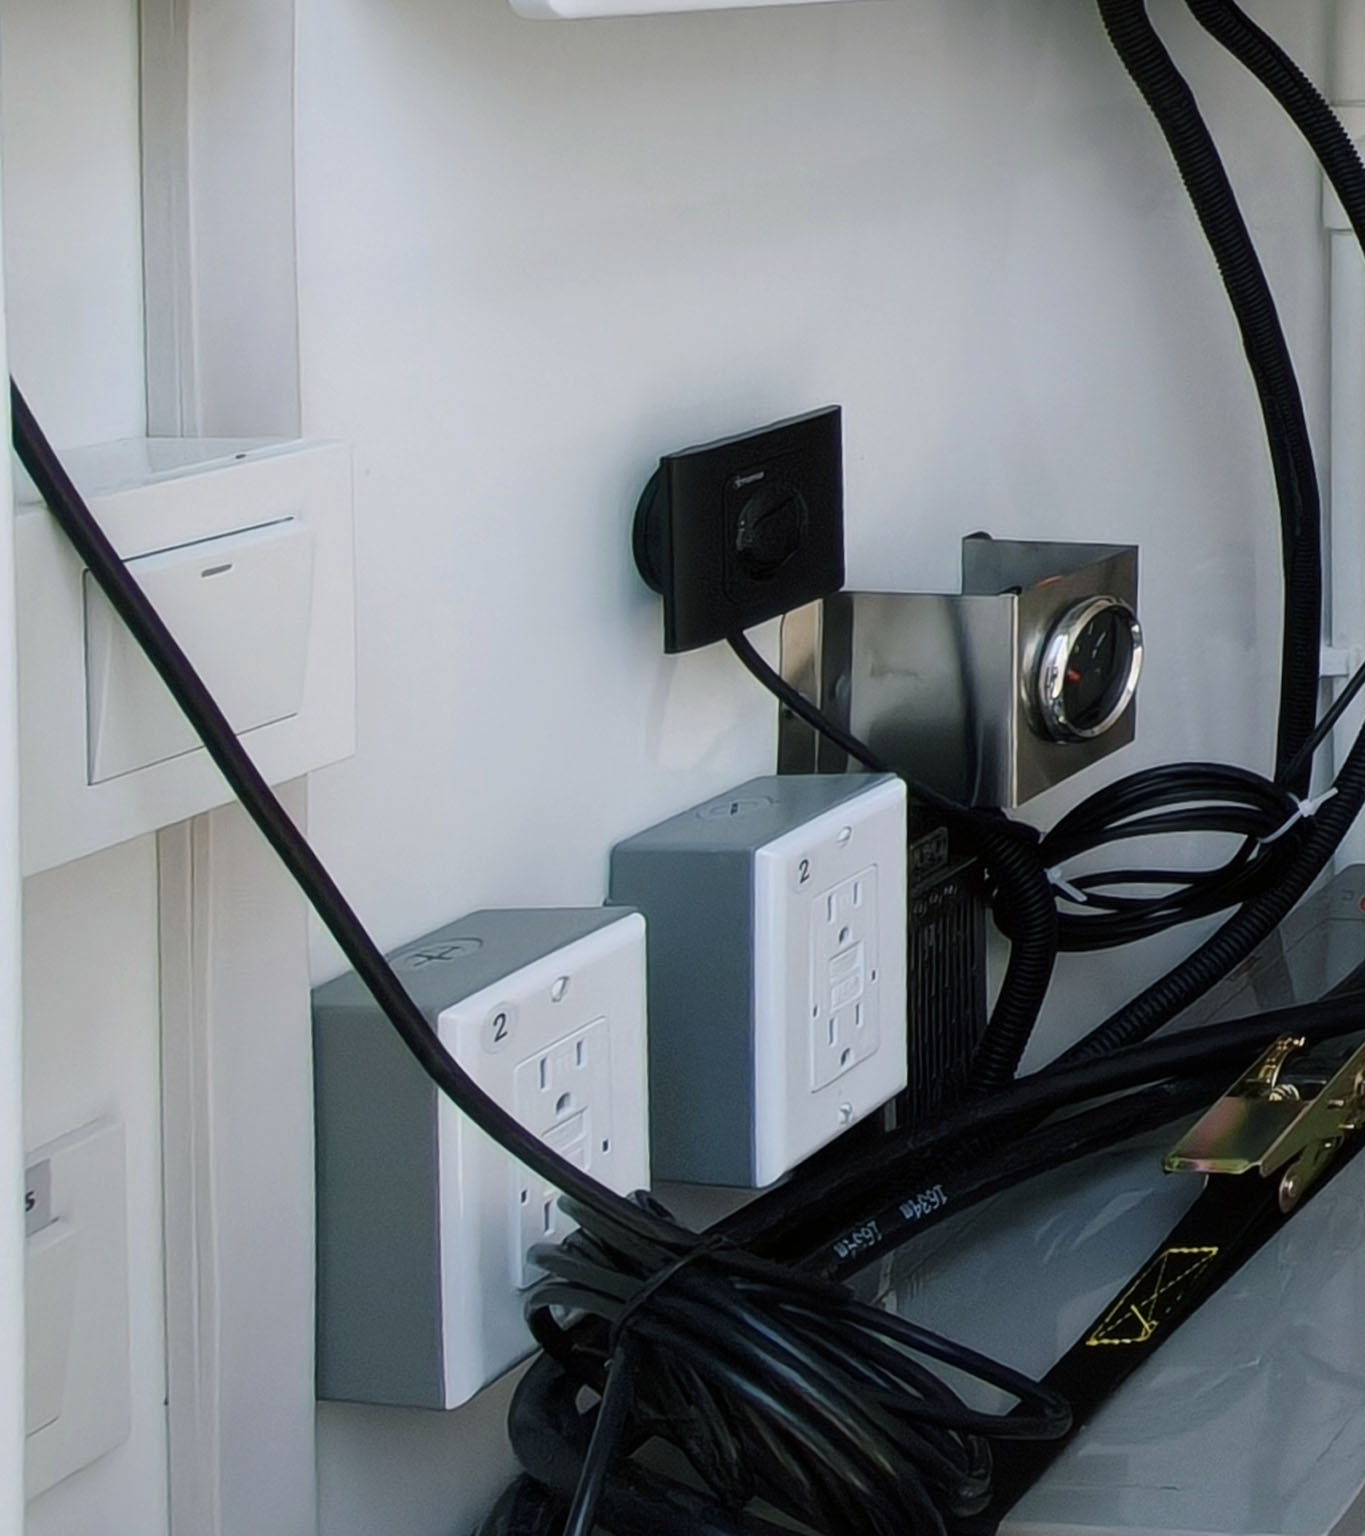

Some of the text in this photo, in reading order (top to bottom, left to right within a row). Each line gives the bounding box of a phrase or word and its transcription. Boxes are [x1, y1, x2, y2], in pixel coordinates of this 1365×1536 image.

[798, 858, 810, 884] 2
[492, 1012, 508, 1043] 2
[899, 1184, 948, 1219] 1634m
